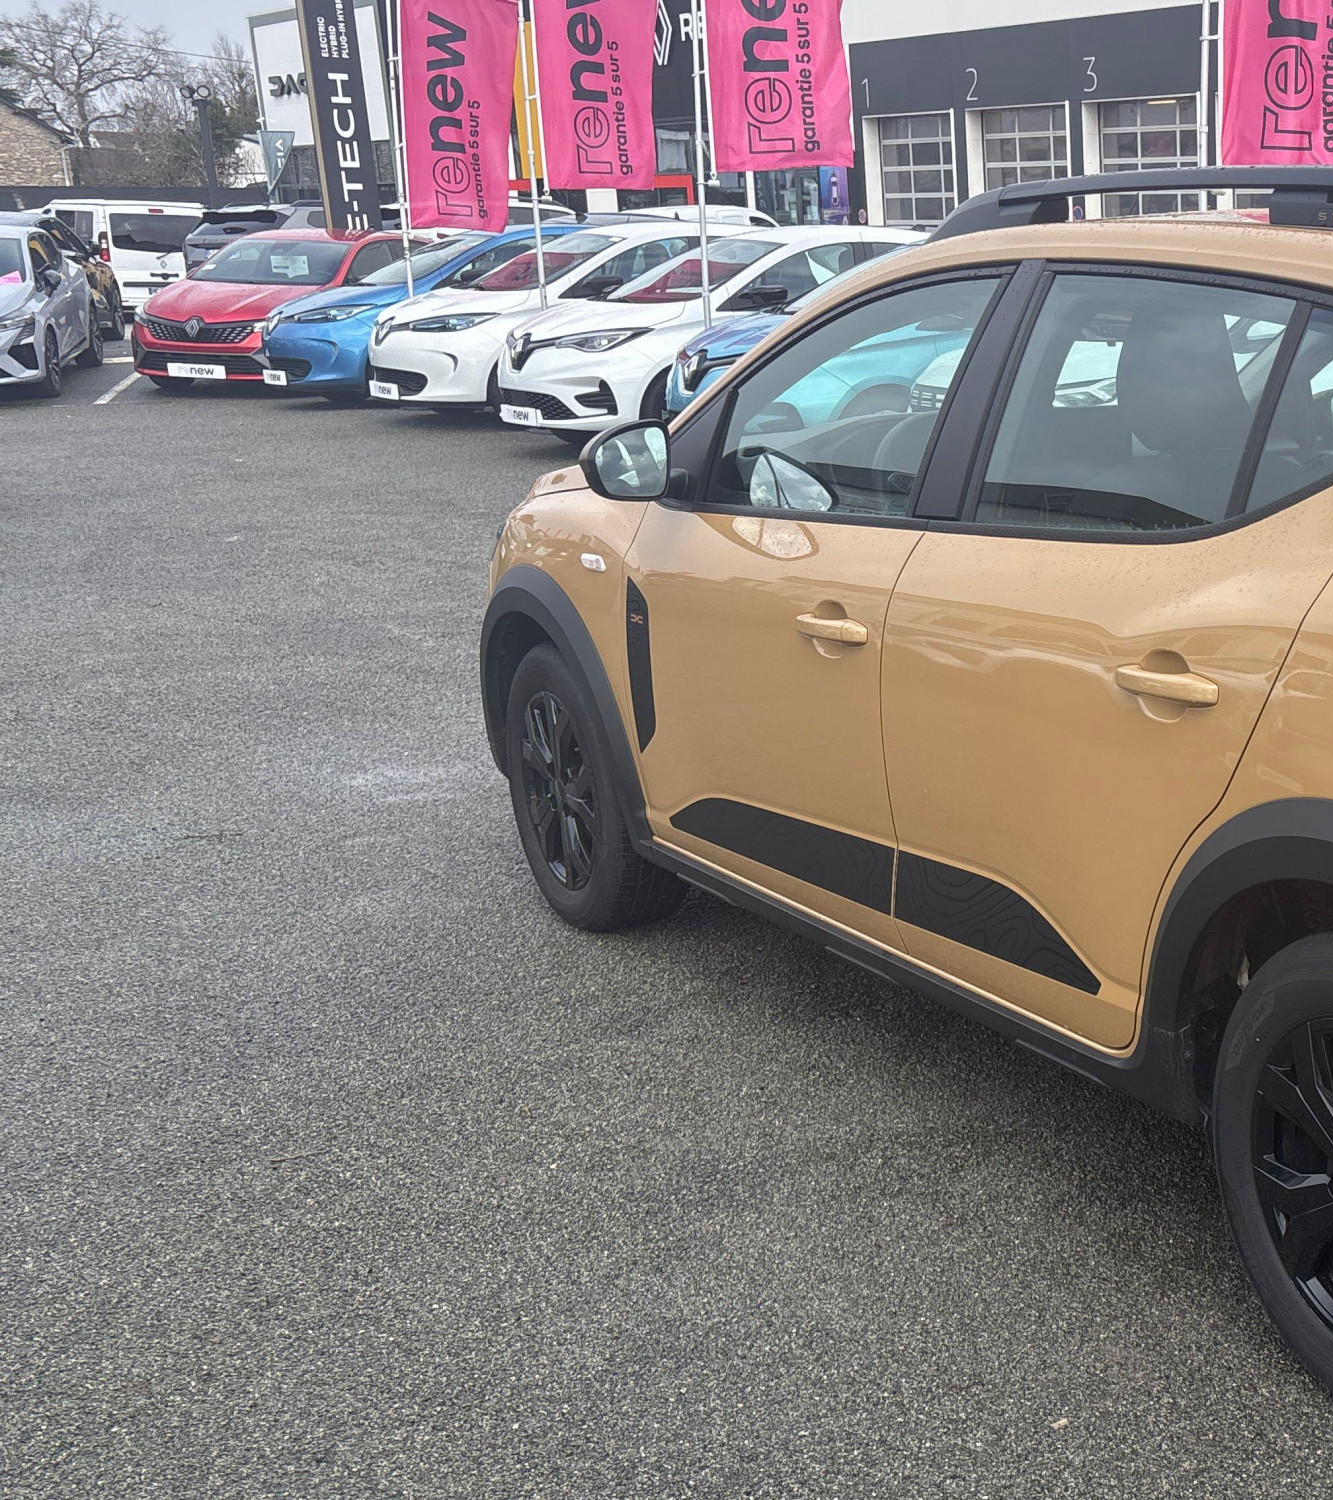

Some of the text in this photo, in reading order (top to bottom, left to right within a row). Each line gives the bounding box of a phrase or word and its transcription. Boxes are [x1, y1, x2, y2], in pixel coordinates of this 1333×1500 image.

[316, 16, 330, 58] ELECTRIC
[328, 25, 340, 58] HYBRID
[338, 22, 350, 59] PLUG-IN
[792, 2, 821, 153] garantie 5 sur 5
[1082, 56, 1098, 93] 3
[426, 10, 474, 218] renew
[565, 0, 614, 175] rene
[606, 40, 634, 176] garantie 5 sur 5
[861, 78, 870, 109] 1
[965, 67, 979, 101] 2
[327, 72, 370, 231] E-TECH
[467, 99, 489, 220] garantie 5 sur 5
